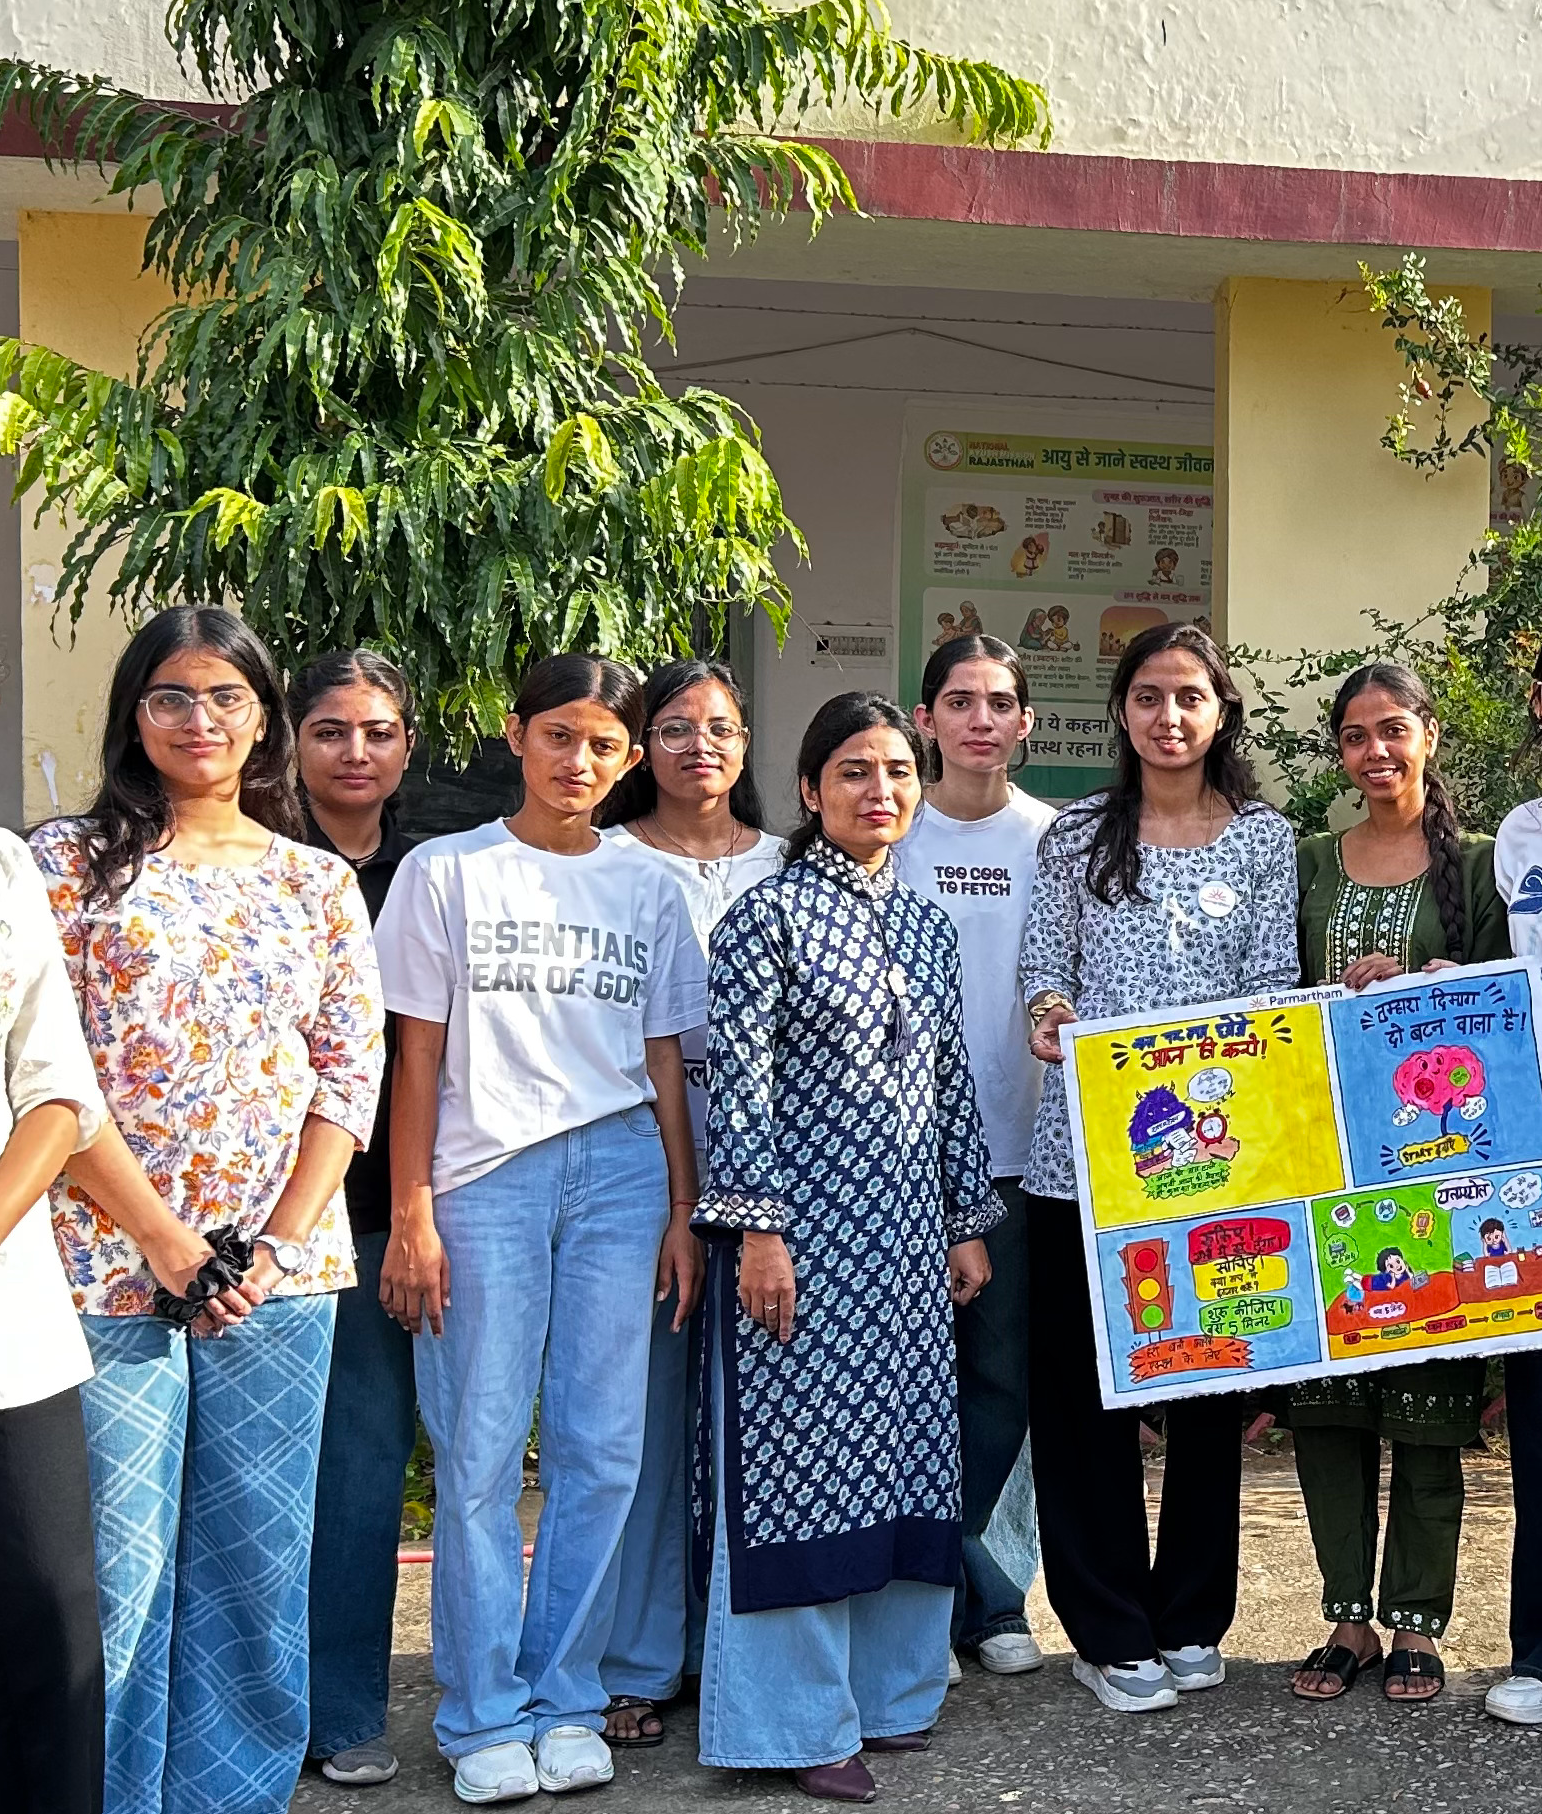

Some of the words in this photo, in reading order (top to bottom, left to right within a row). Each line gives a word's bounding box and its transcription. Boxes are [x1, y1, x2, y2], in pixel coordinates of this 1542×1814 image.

[968, 457, 1035, 469] RAJASTHAN
[1041, 449, 1072, 471] आयु
[1075, 446, 1091, 466] से
[1093, 448, 1126, 469] जाने
[1128, 453, 1172, 471] स्वस्थ
[1174, 453, 1215, 473] जीवन
[1047, 713, 1061, 732] ये
[1065, 718, 1110, 734] कहना
[1029, 740, 1062, 755] वस्थ
[1066, 742, 1103, 758] रहना
[933, 866, 967, 880] TOO
[970, 867, 1011, 881] COOL
[936, 881, 958, 894] TO
[961, 882, 1011, 896] FETCH
[465, 918, 649, 975] SSENTIALS
[467, 963, 537, 992] EAR
[546, 965, 585, 995] OF
[1269, 989, 1343, 1006] Parmartham
[1374, 995, 1422, 1024] तुम्हारा
[1429, 987, 1481, 1012] दिमाग
[1384, 1022, 1405, 1048] दो
[1410, 1018, 1447, 1043] बटन
[1453, 1013, 1496, 1035] वाला
[1228, 1320, 1239, 1338] 5
[1241, 1315, 1270, 1331] मिनट
